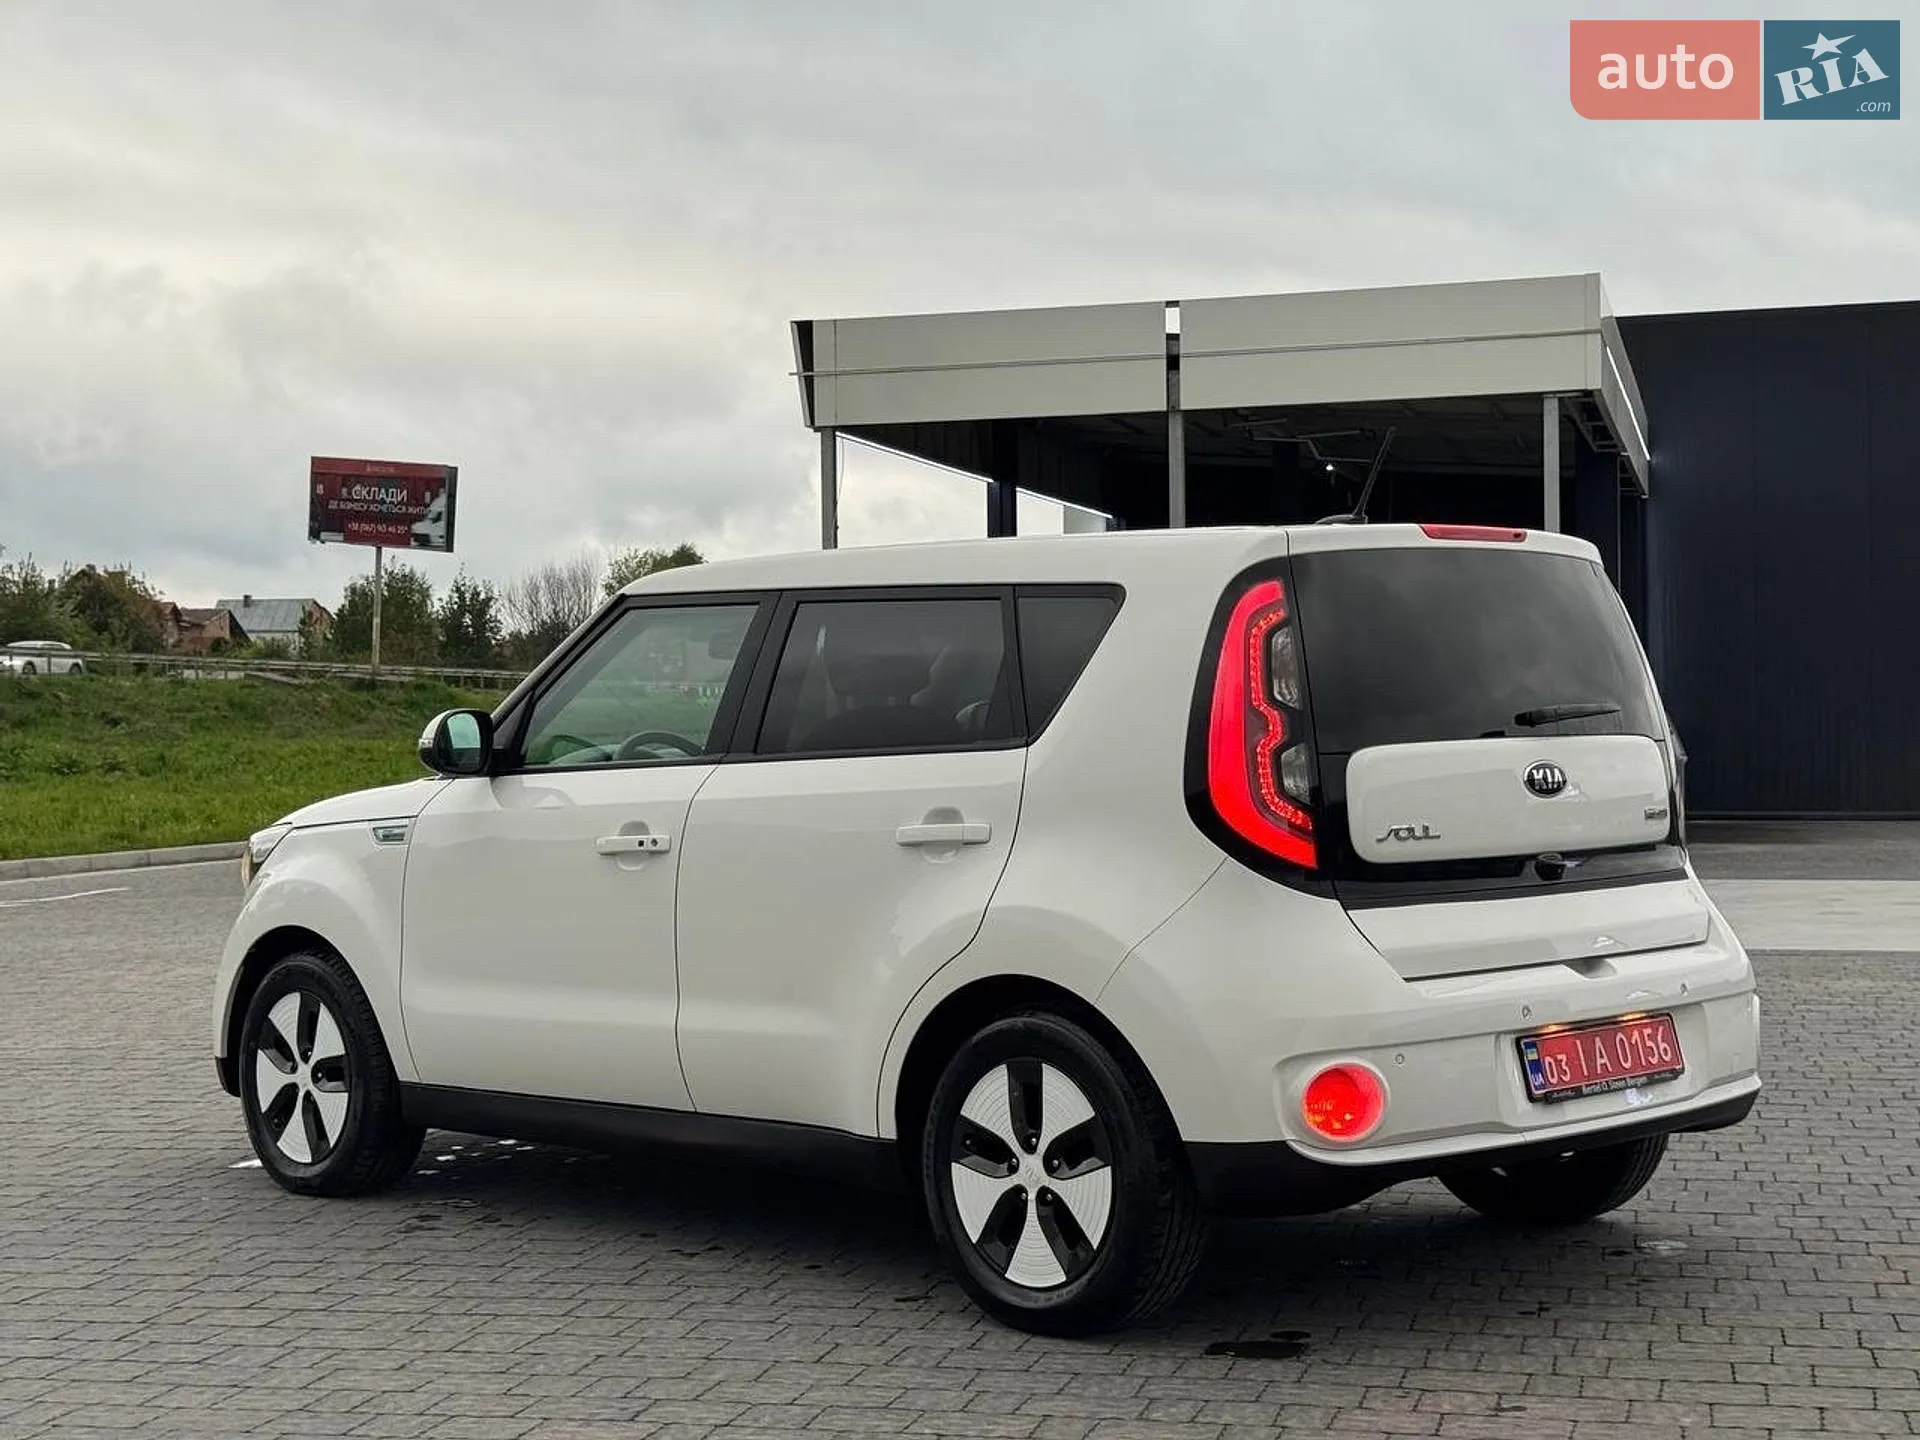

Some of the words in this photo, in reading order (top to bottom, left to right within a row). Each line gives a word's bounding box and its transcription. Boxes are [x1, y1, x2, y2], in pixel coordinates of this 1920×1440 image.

[351, 486, 408, 504] СКЛАДИ
[1531, 767, 1564, 790] KIA
[1375, 823, 1441, 843] SOUL
[1544, 1054, 1571, 1085] 03
[1615, 1025, 1672, 1071] 0156
[1531, 1072, 1545, 1087] UA
